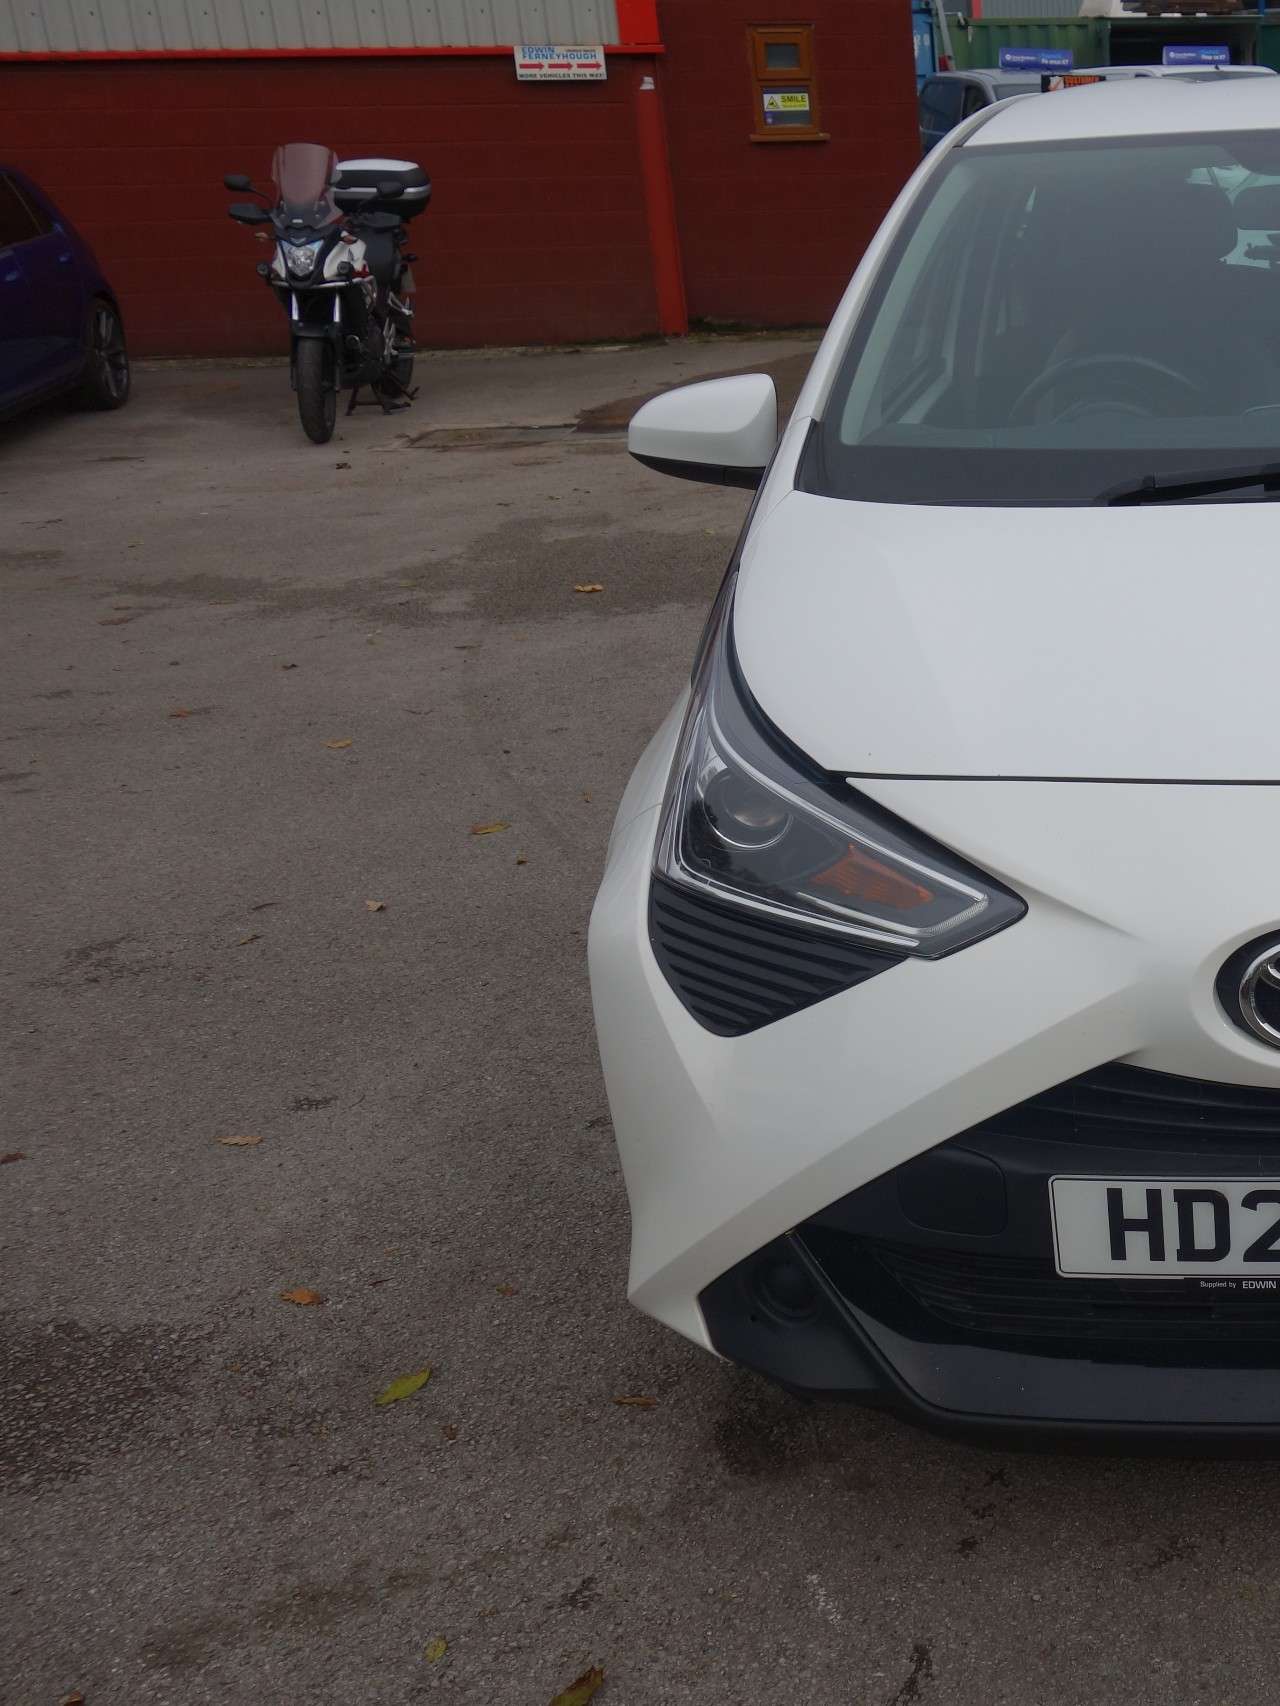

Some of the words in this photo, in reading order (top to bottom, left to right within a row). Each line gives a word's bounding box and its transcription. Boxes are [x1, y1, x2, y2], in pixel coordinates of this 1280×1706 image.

[522, 52, 597, 60] FERNEYHOUGH
[781, 95, 806, 103] SMILE
[1200, 1281, 1227, 1289] Supplied
[1228, 1281, 1237, 1289] by
[1242, 1280, 1277, 1289] EDWIN
